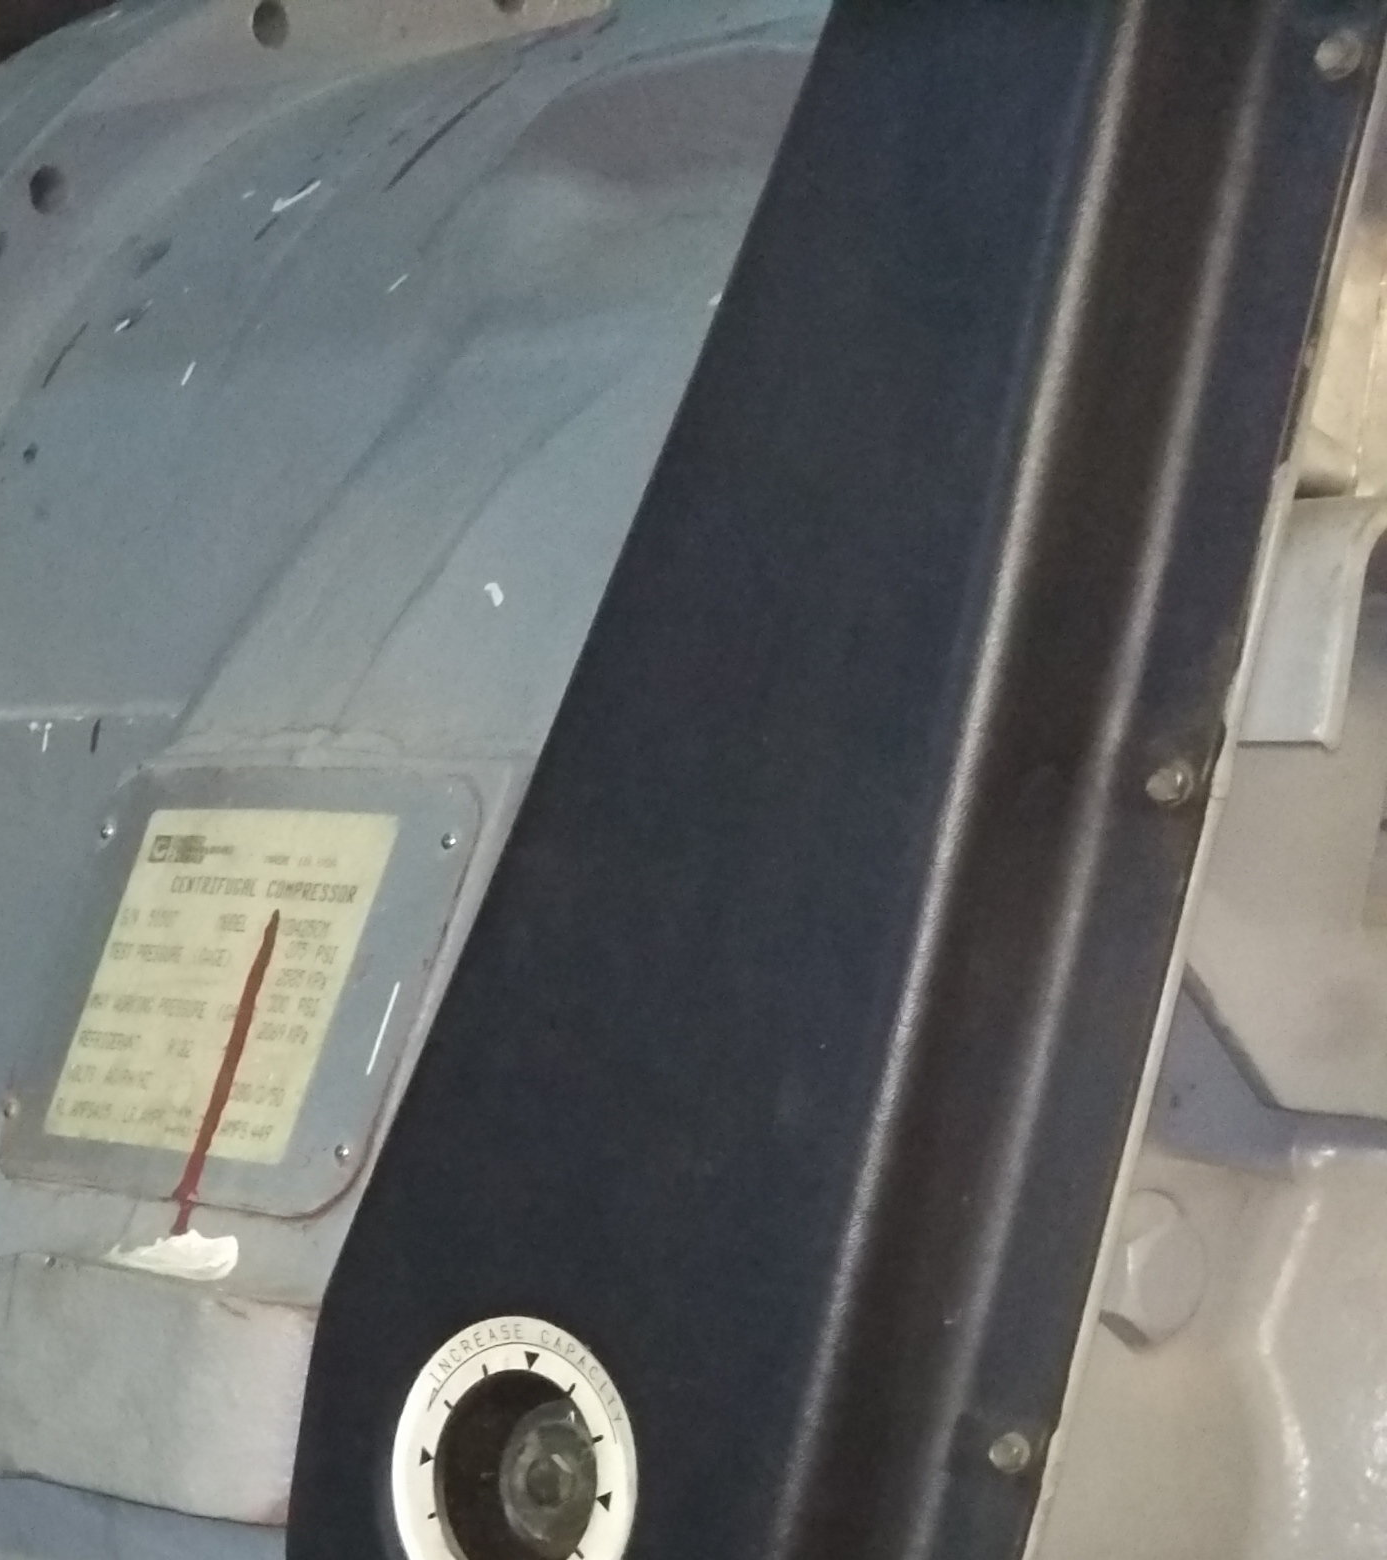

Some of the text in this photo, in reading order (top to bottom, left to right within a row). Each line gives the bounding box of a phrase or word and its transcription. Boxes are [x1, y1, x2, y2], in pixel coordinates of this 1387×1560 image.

[170, 875, 359, 904] CENTRIFUGAL COMPRESSOR
[430, 1324, 624, 1422] INCREASE CAPACITY
